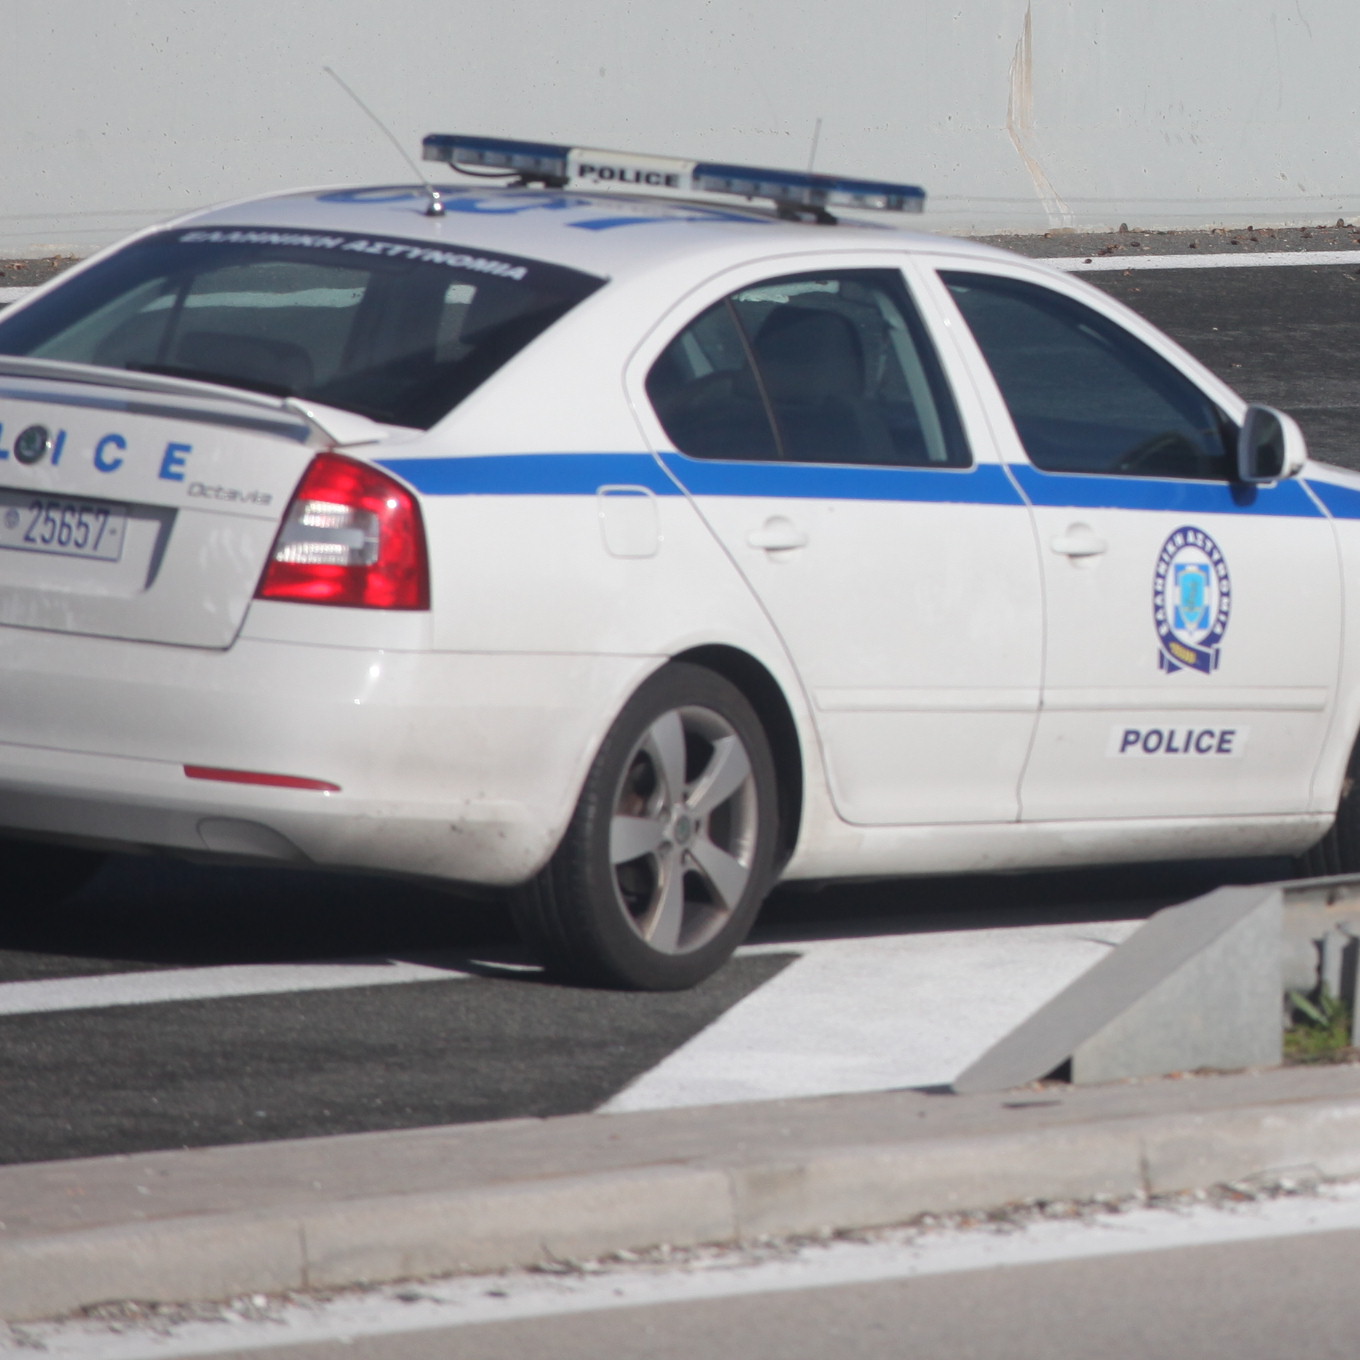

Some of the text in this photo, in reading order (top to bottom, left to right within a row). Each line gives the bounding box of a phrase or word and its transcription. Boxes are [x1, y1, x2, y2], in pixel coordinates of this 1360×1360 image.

[579, 164, 679, 189] POLICE
[341, 239, 529, 281] ΑΣΤΥΝΟΜΙΑ
[186, 481, 274, 506] Octavia
[23, 498, 111, 551] 25657
[1119, 729, 1236, 754] POLICE
